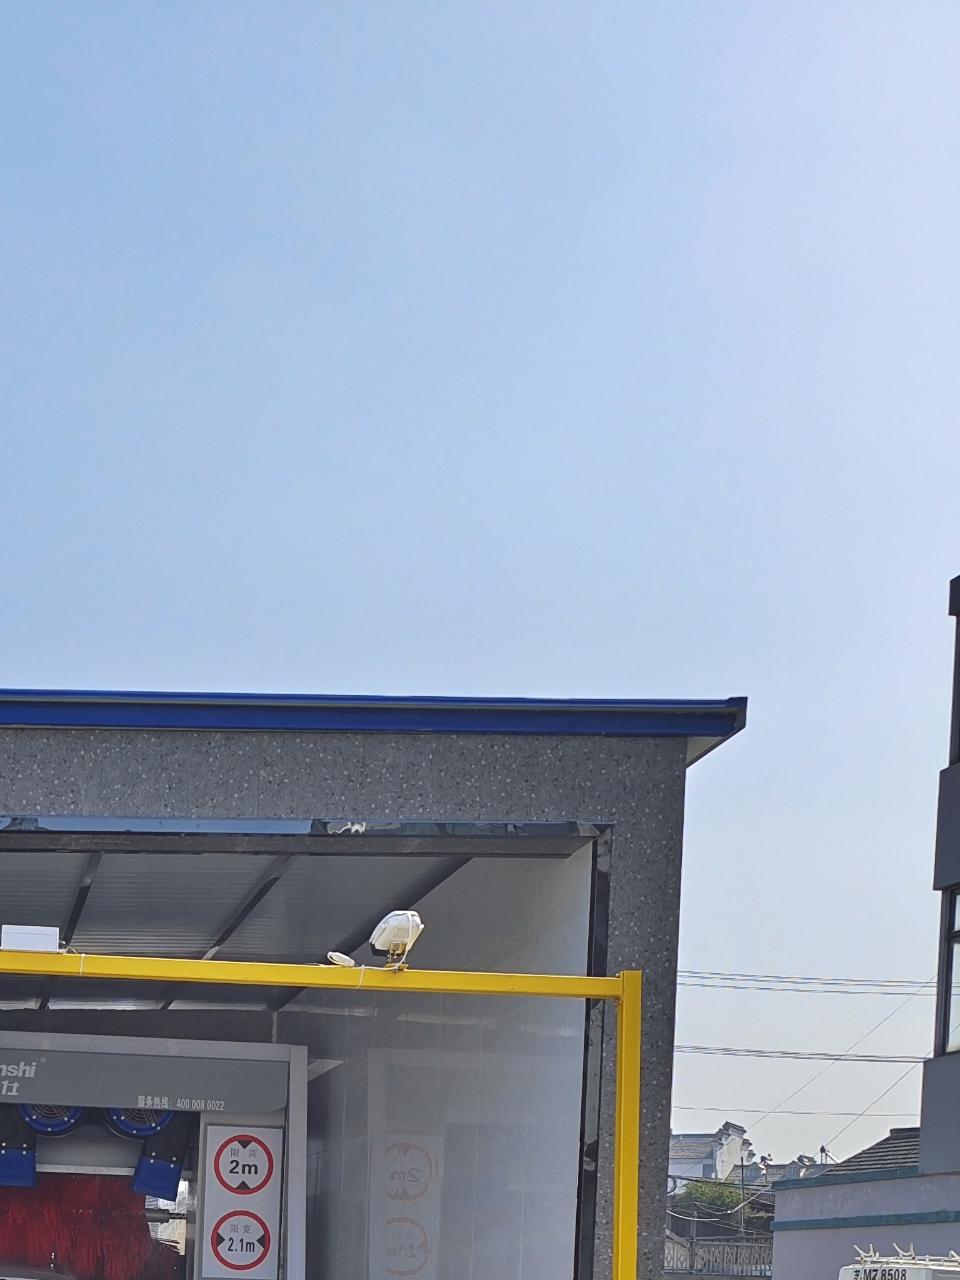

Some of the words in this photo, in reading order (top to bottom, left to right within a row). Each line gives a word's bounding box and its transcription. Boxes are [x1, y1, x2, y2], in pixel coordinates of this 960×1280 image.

[176, 1099, 190, 1109] 400
[191, 1100, 205, 1110] 008
[207, 1100, 224, 1111] 0022
[229, 1160, 258, 1175] 2m
[227, 1237, 256, 1253] 2.1m
